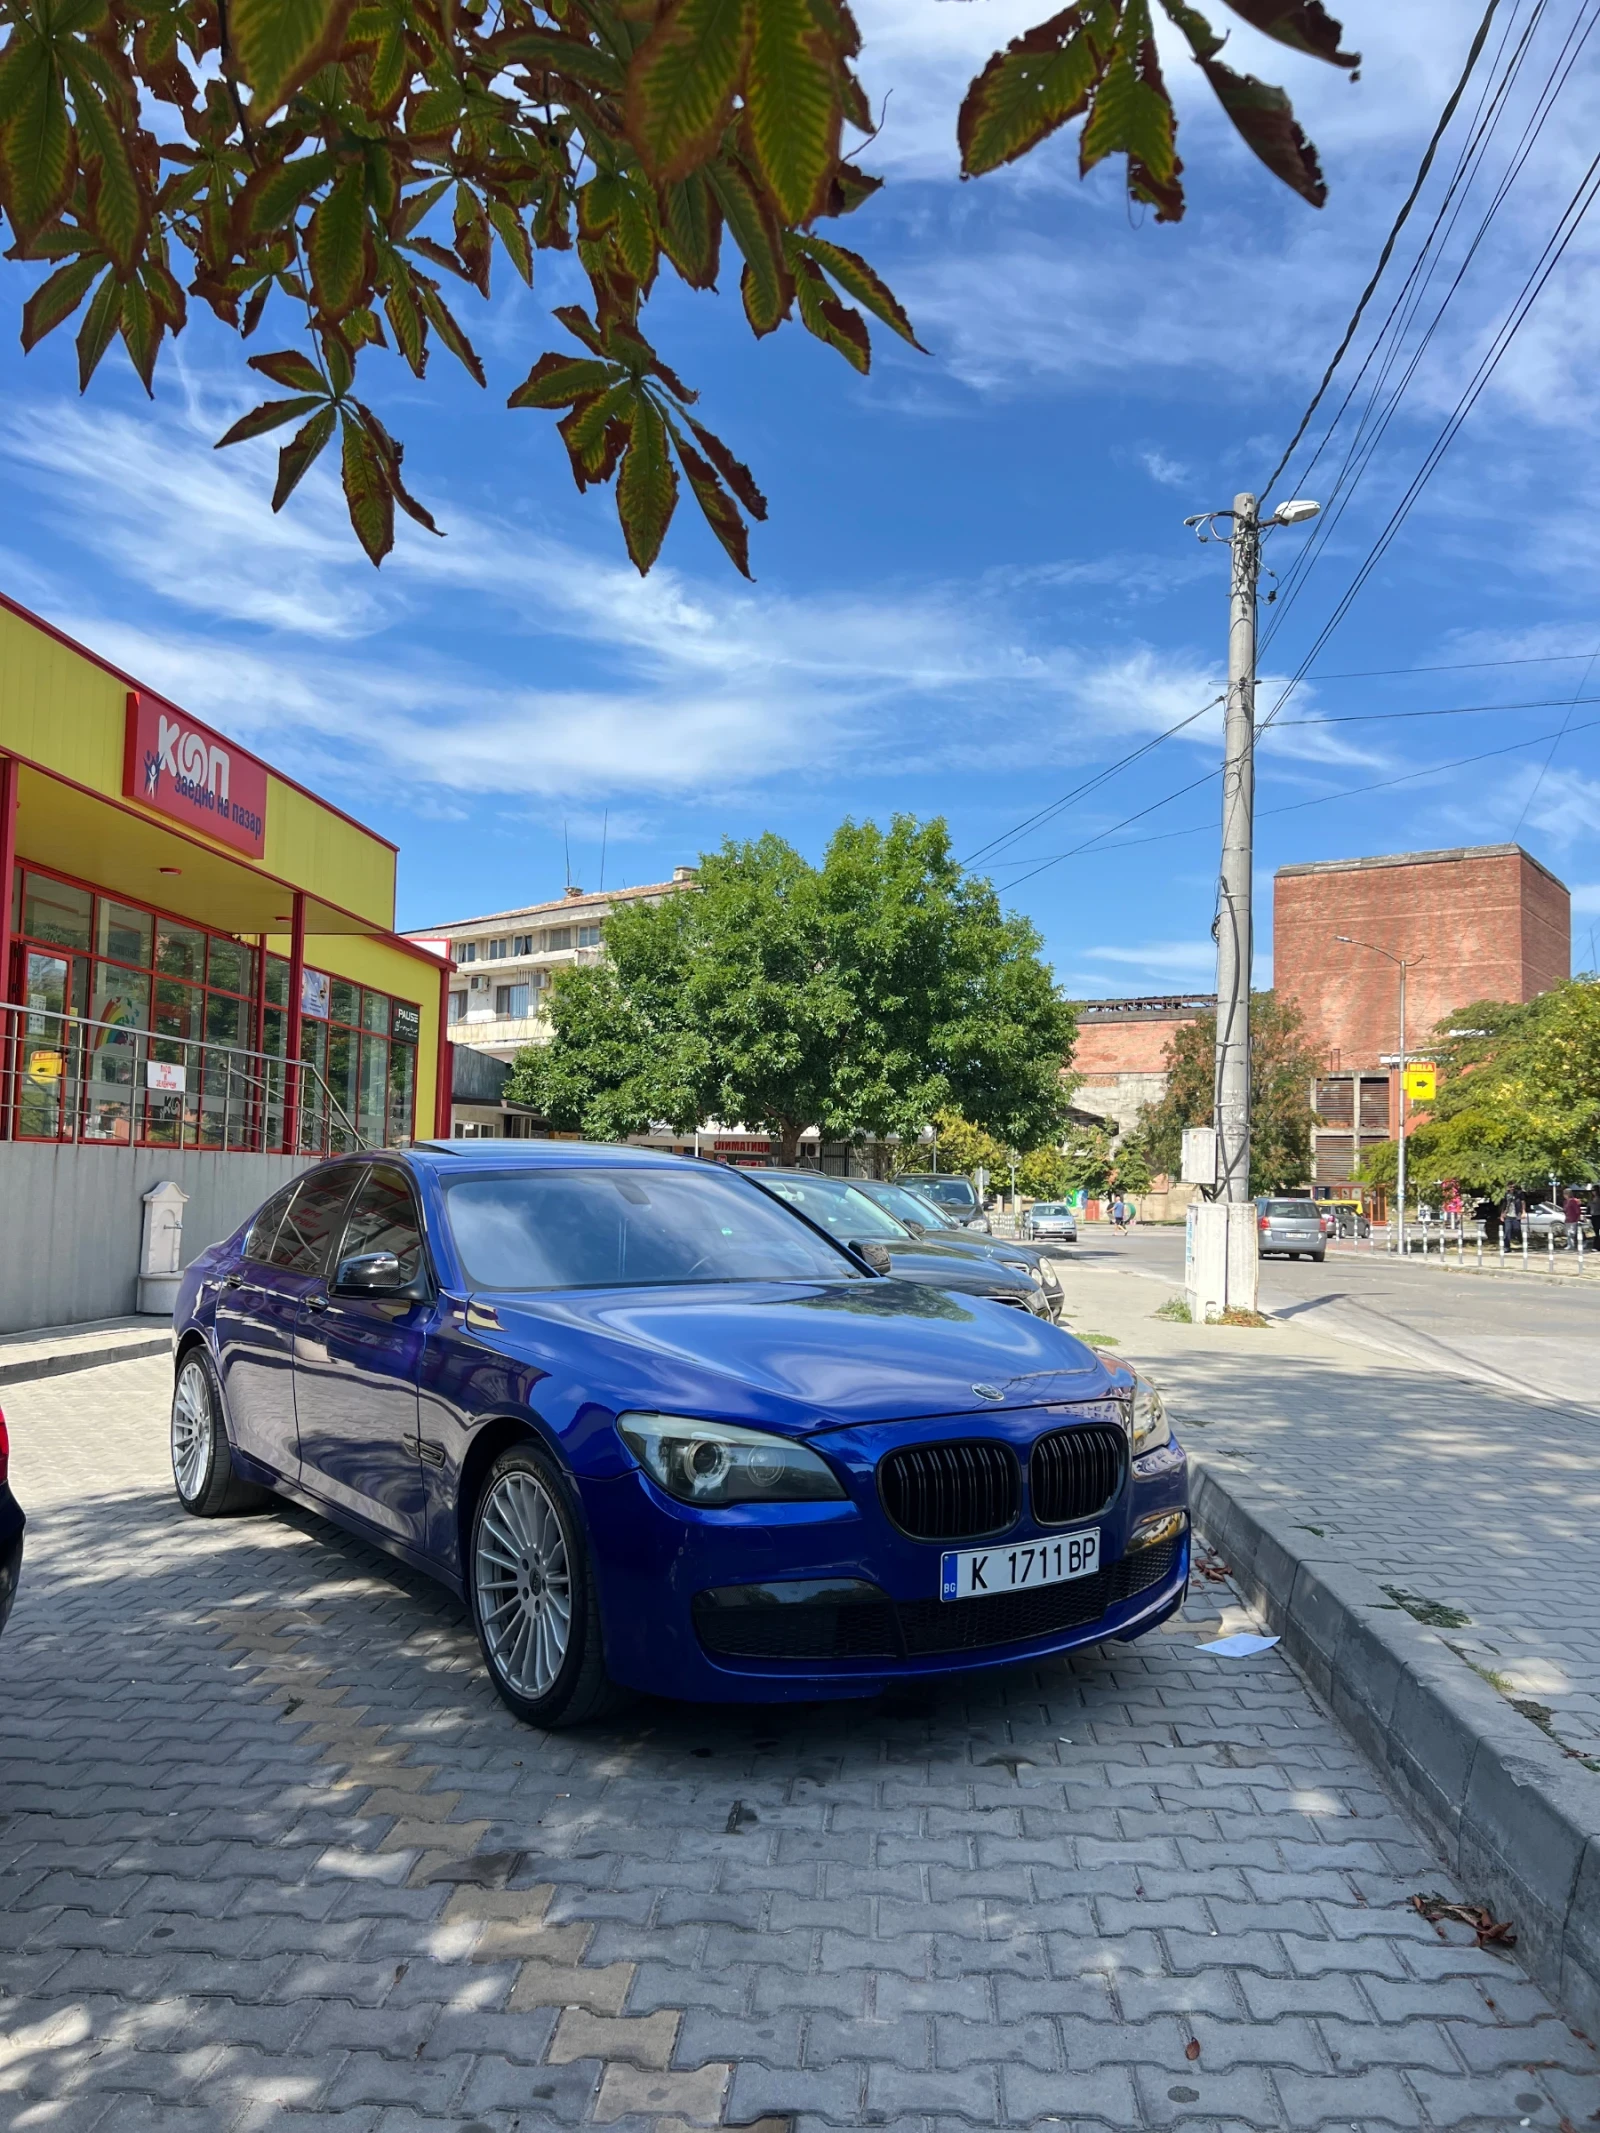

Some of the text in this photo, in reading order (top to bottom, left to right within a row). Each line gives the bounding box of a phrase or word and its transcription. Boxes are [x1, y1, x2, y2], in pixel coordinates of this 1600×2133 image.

[158, 715, 230, 803] КОП
[174, 771, 262, 841] заедно на пазар
[943, 1582, 956, 1594] BG
[971, 1556, 989, 1590] K
